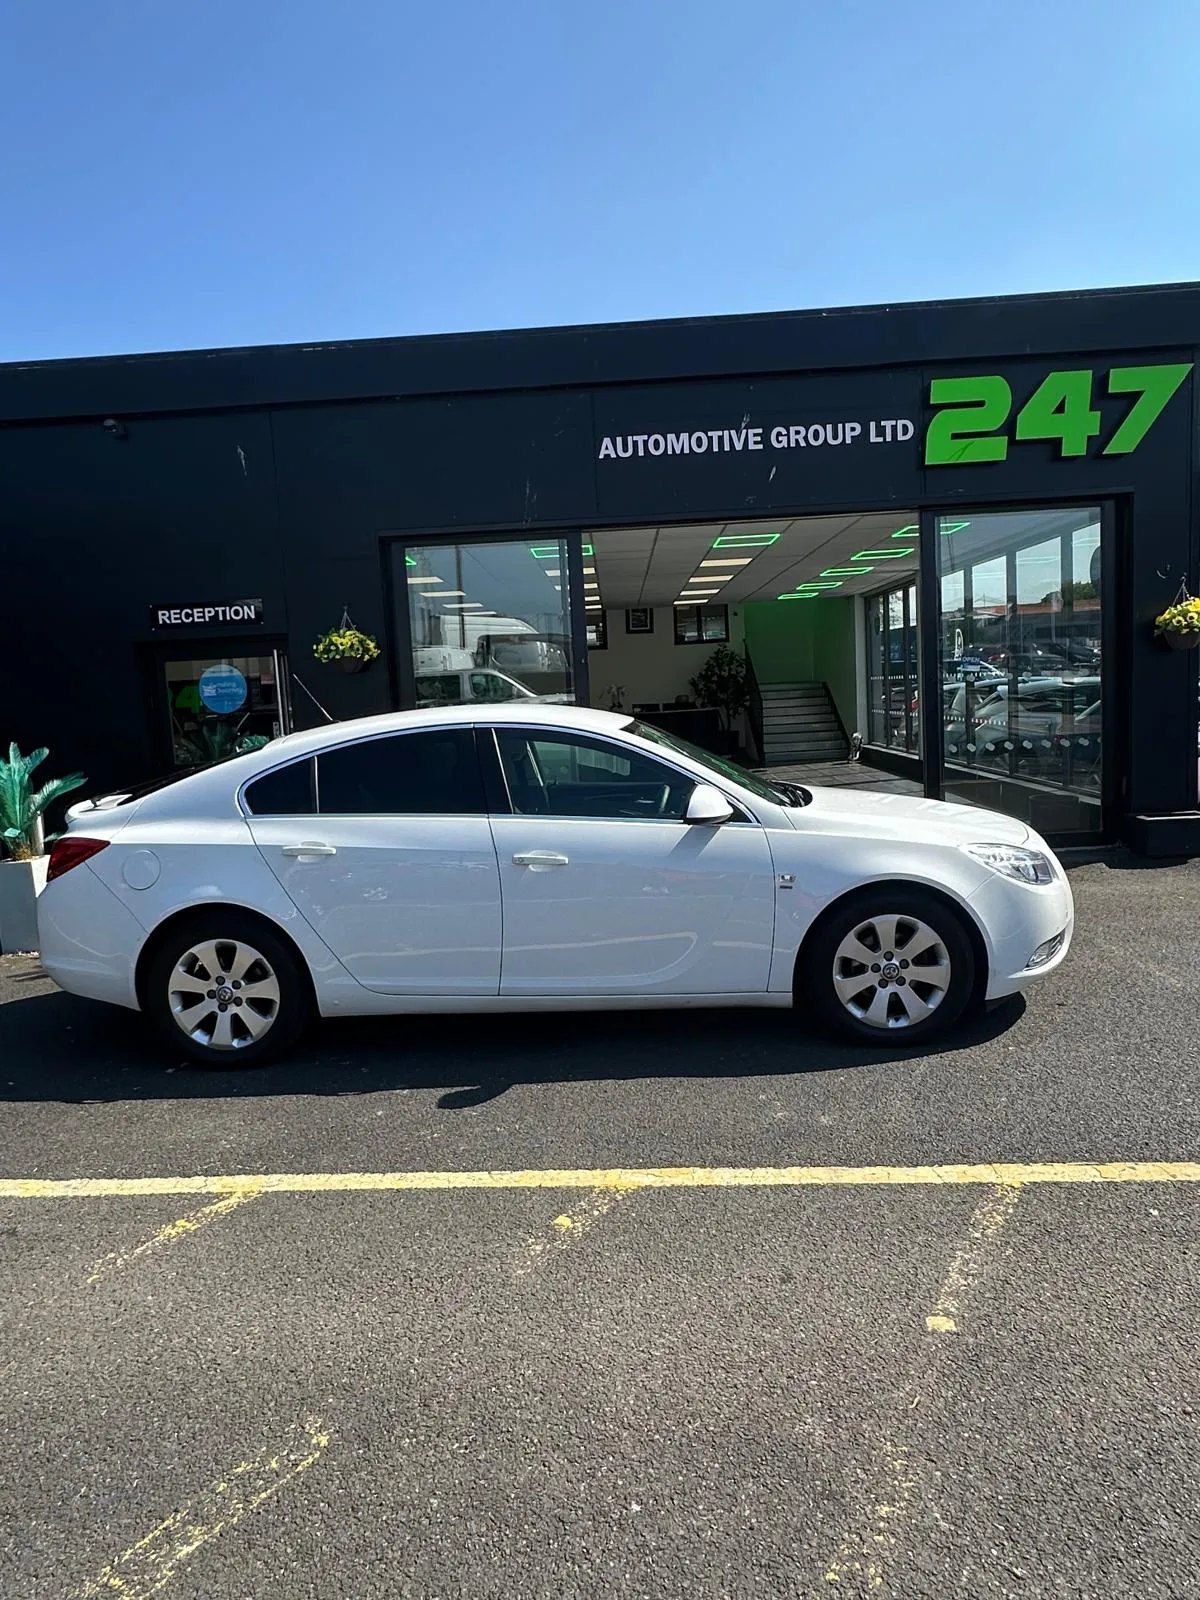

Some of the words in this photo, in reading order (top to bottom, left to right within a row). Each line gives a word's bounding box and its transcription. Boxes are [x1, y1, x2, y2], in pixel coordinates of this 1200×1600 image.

[925, 363, 1195, 466] 247
[599, 428, 764, 459] AUTOMOTIVE
[770, 421, 862, 449] GROUP
[869, 419, 915, 443] LTD
[157, 605, 256, 625] RECEPTION
